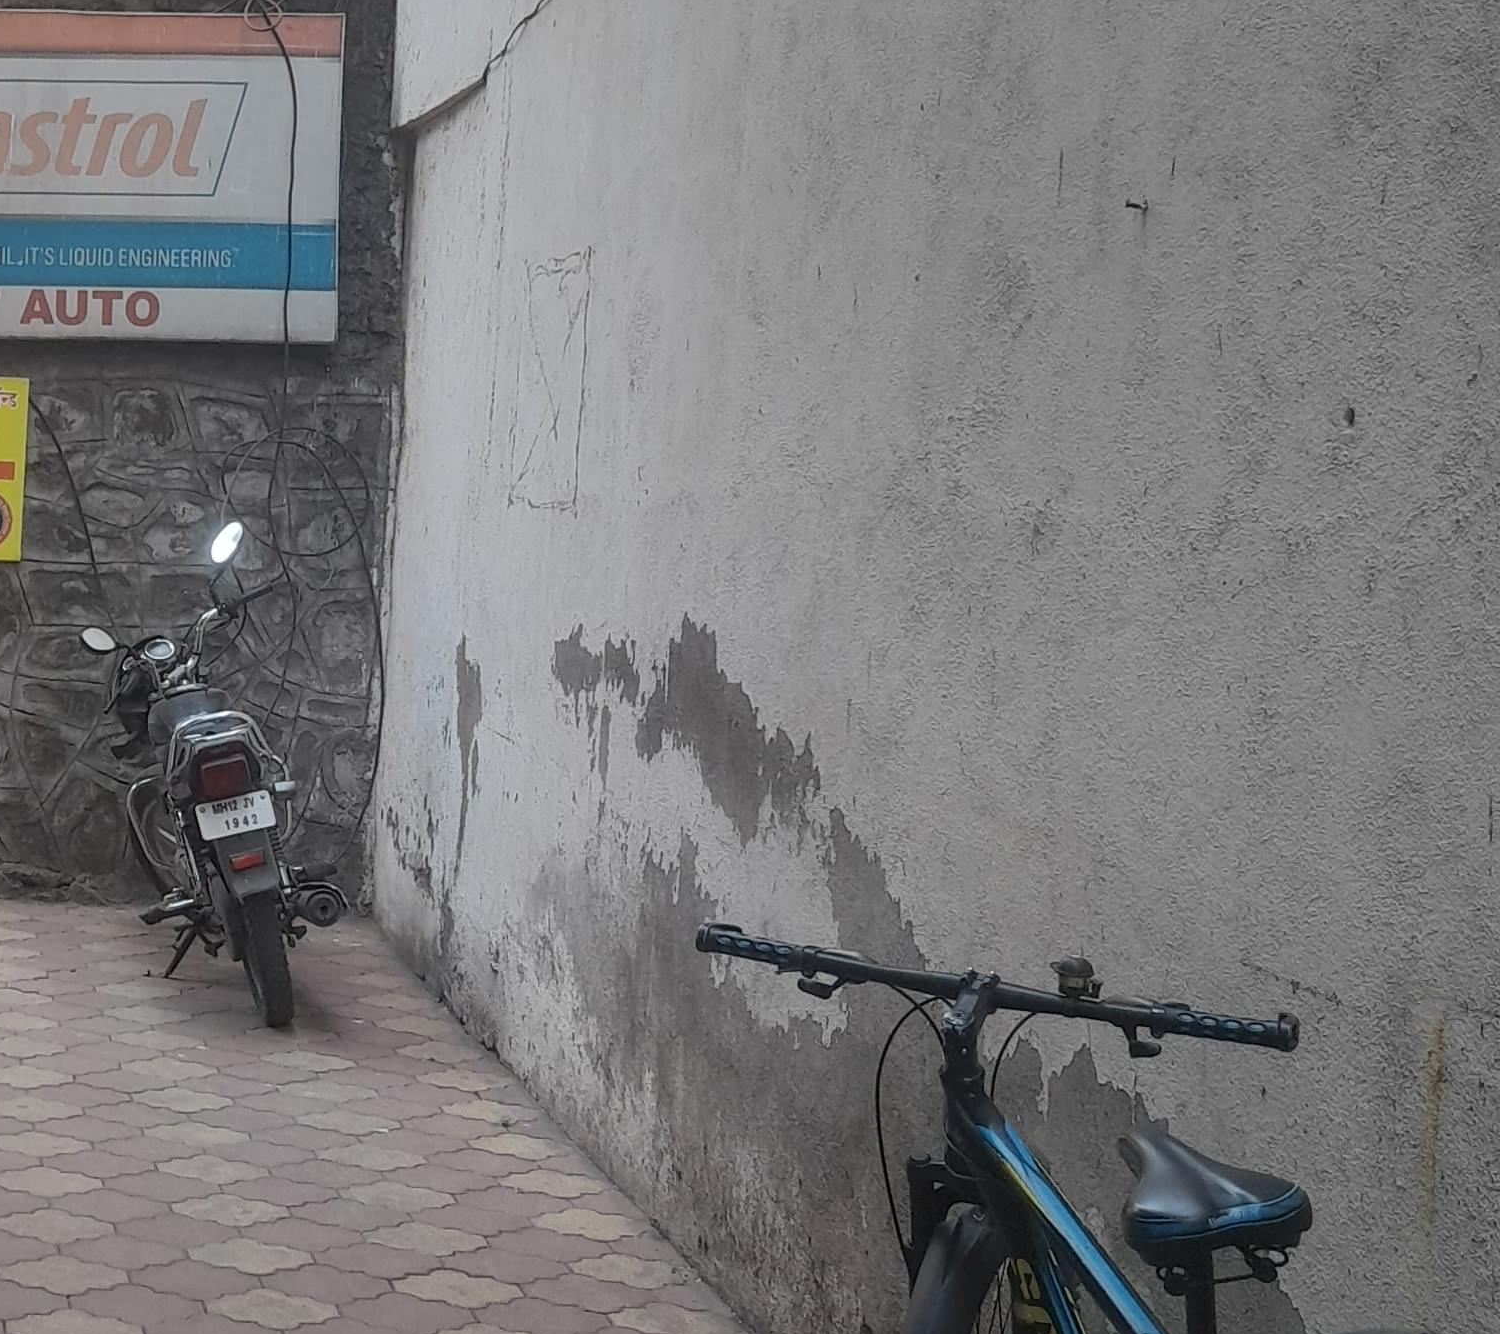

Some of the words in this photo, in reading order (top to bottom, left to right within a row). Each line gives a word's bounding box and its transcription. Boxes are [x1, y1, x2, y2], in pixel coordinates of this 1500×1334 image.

[59, 247, 113, 267] LIQUID
[19, 289, 160, 327] AUTO
[212, 799, 239, 815] MH12
[225, 813, 258, 830] 1942
